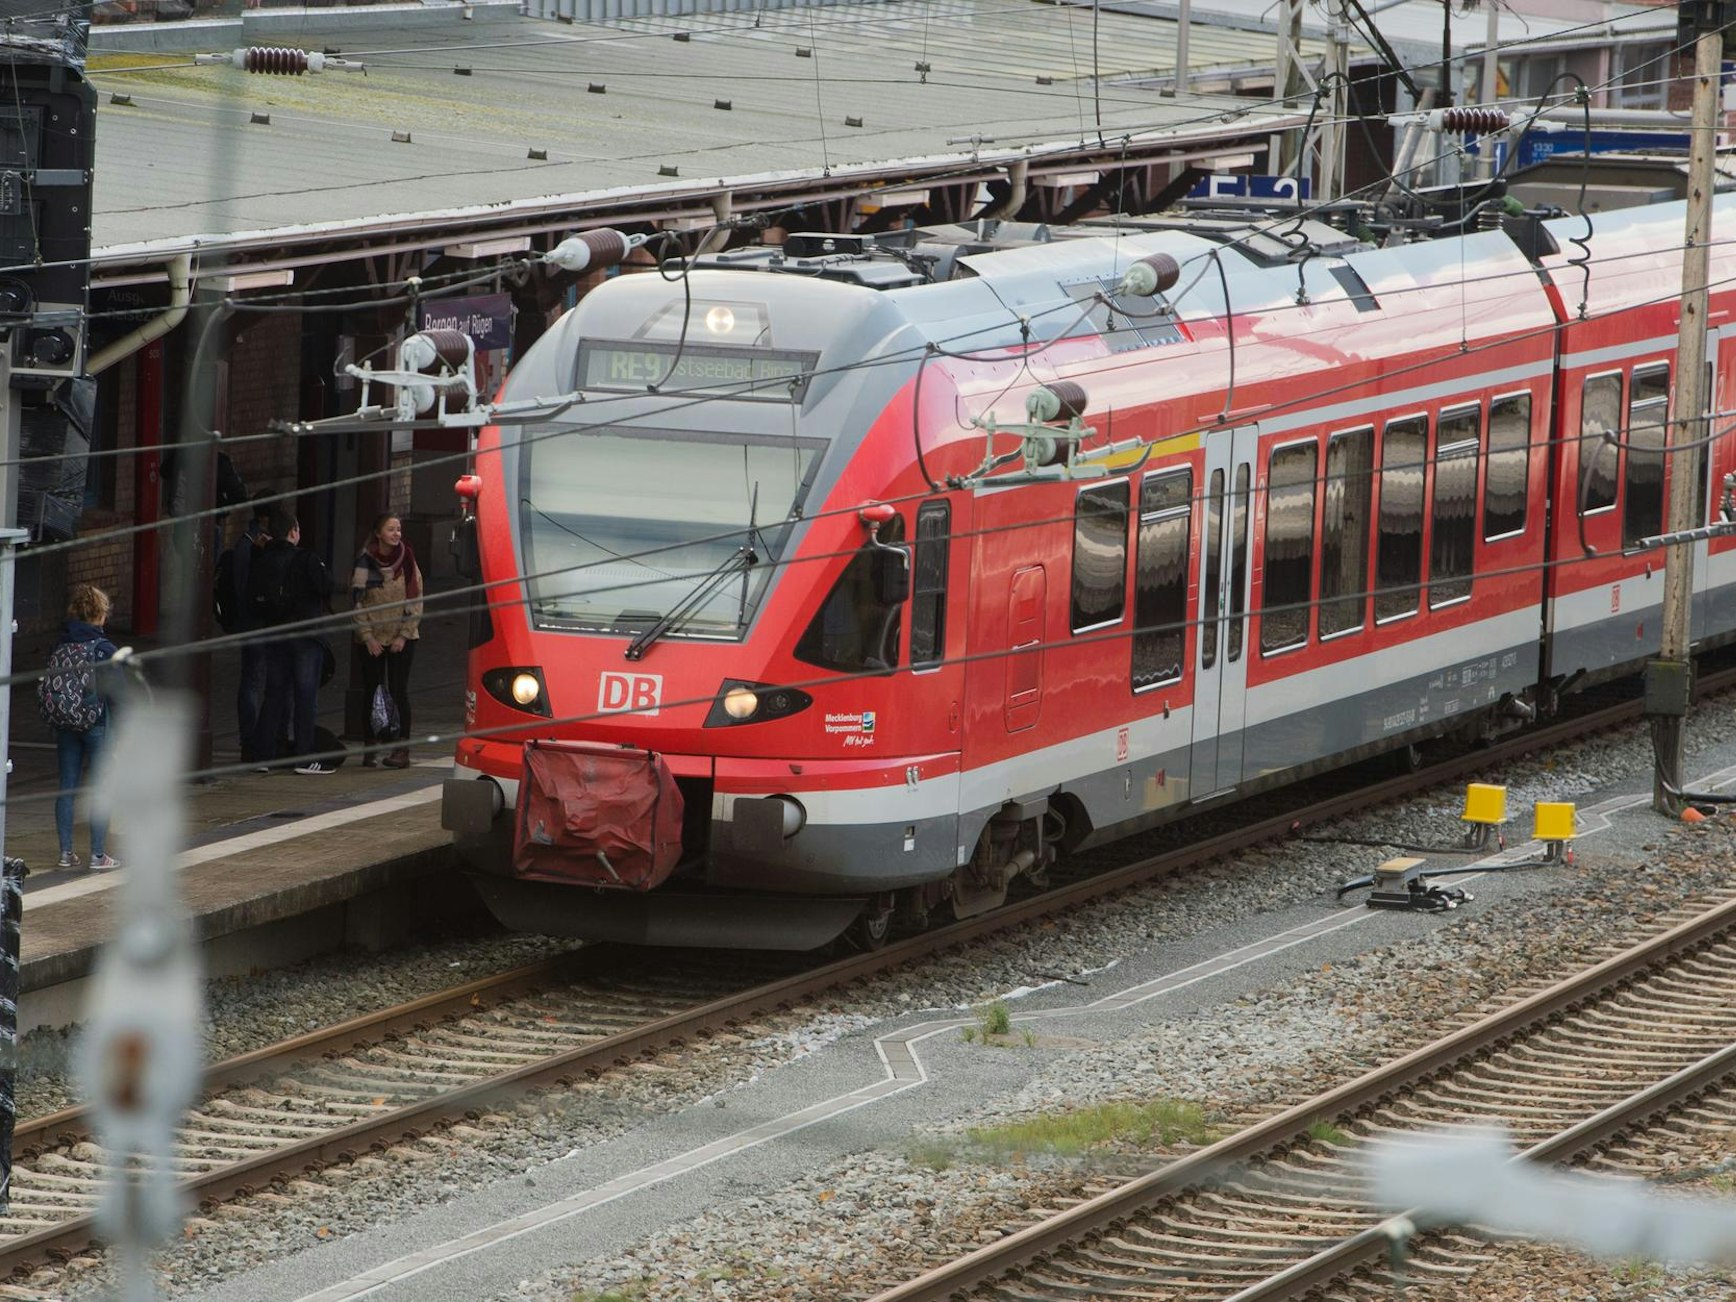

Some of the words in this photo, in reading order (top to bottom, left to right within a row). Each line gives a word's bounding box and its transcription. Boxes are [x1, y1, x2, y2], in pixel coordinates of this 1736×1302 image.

[471, 314, 493, 339] Rügen
[610, 351, 662, 380] RE9
[1257, 477, 1266, 519] 2
[602, 674, 659, 712] DB
[825, 713, 862, 723] Mecklenburg
[825, 725, 861, 734] Vorpommern
